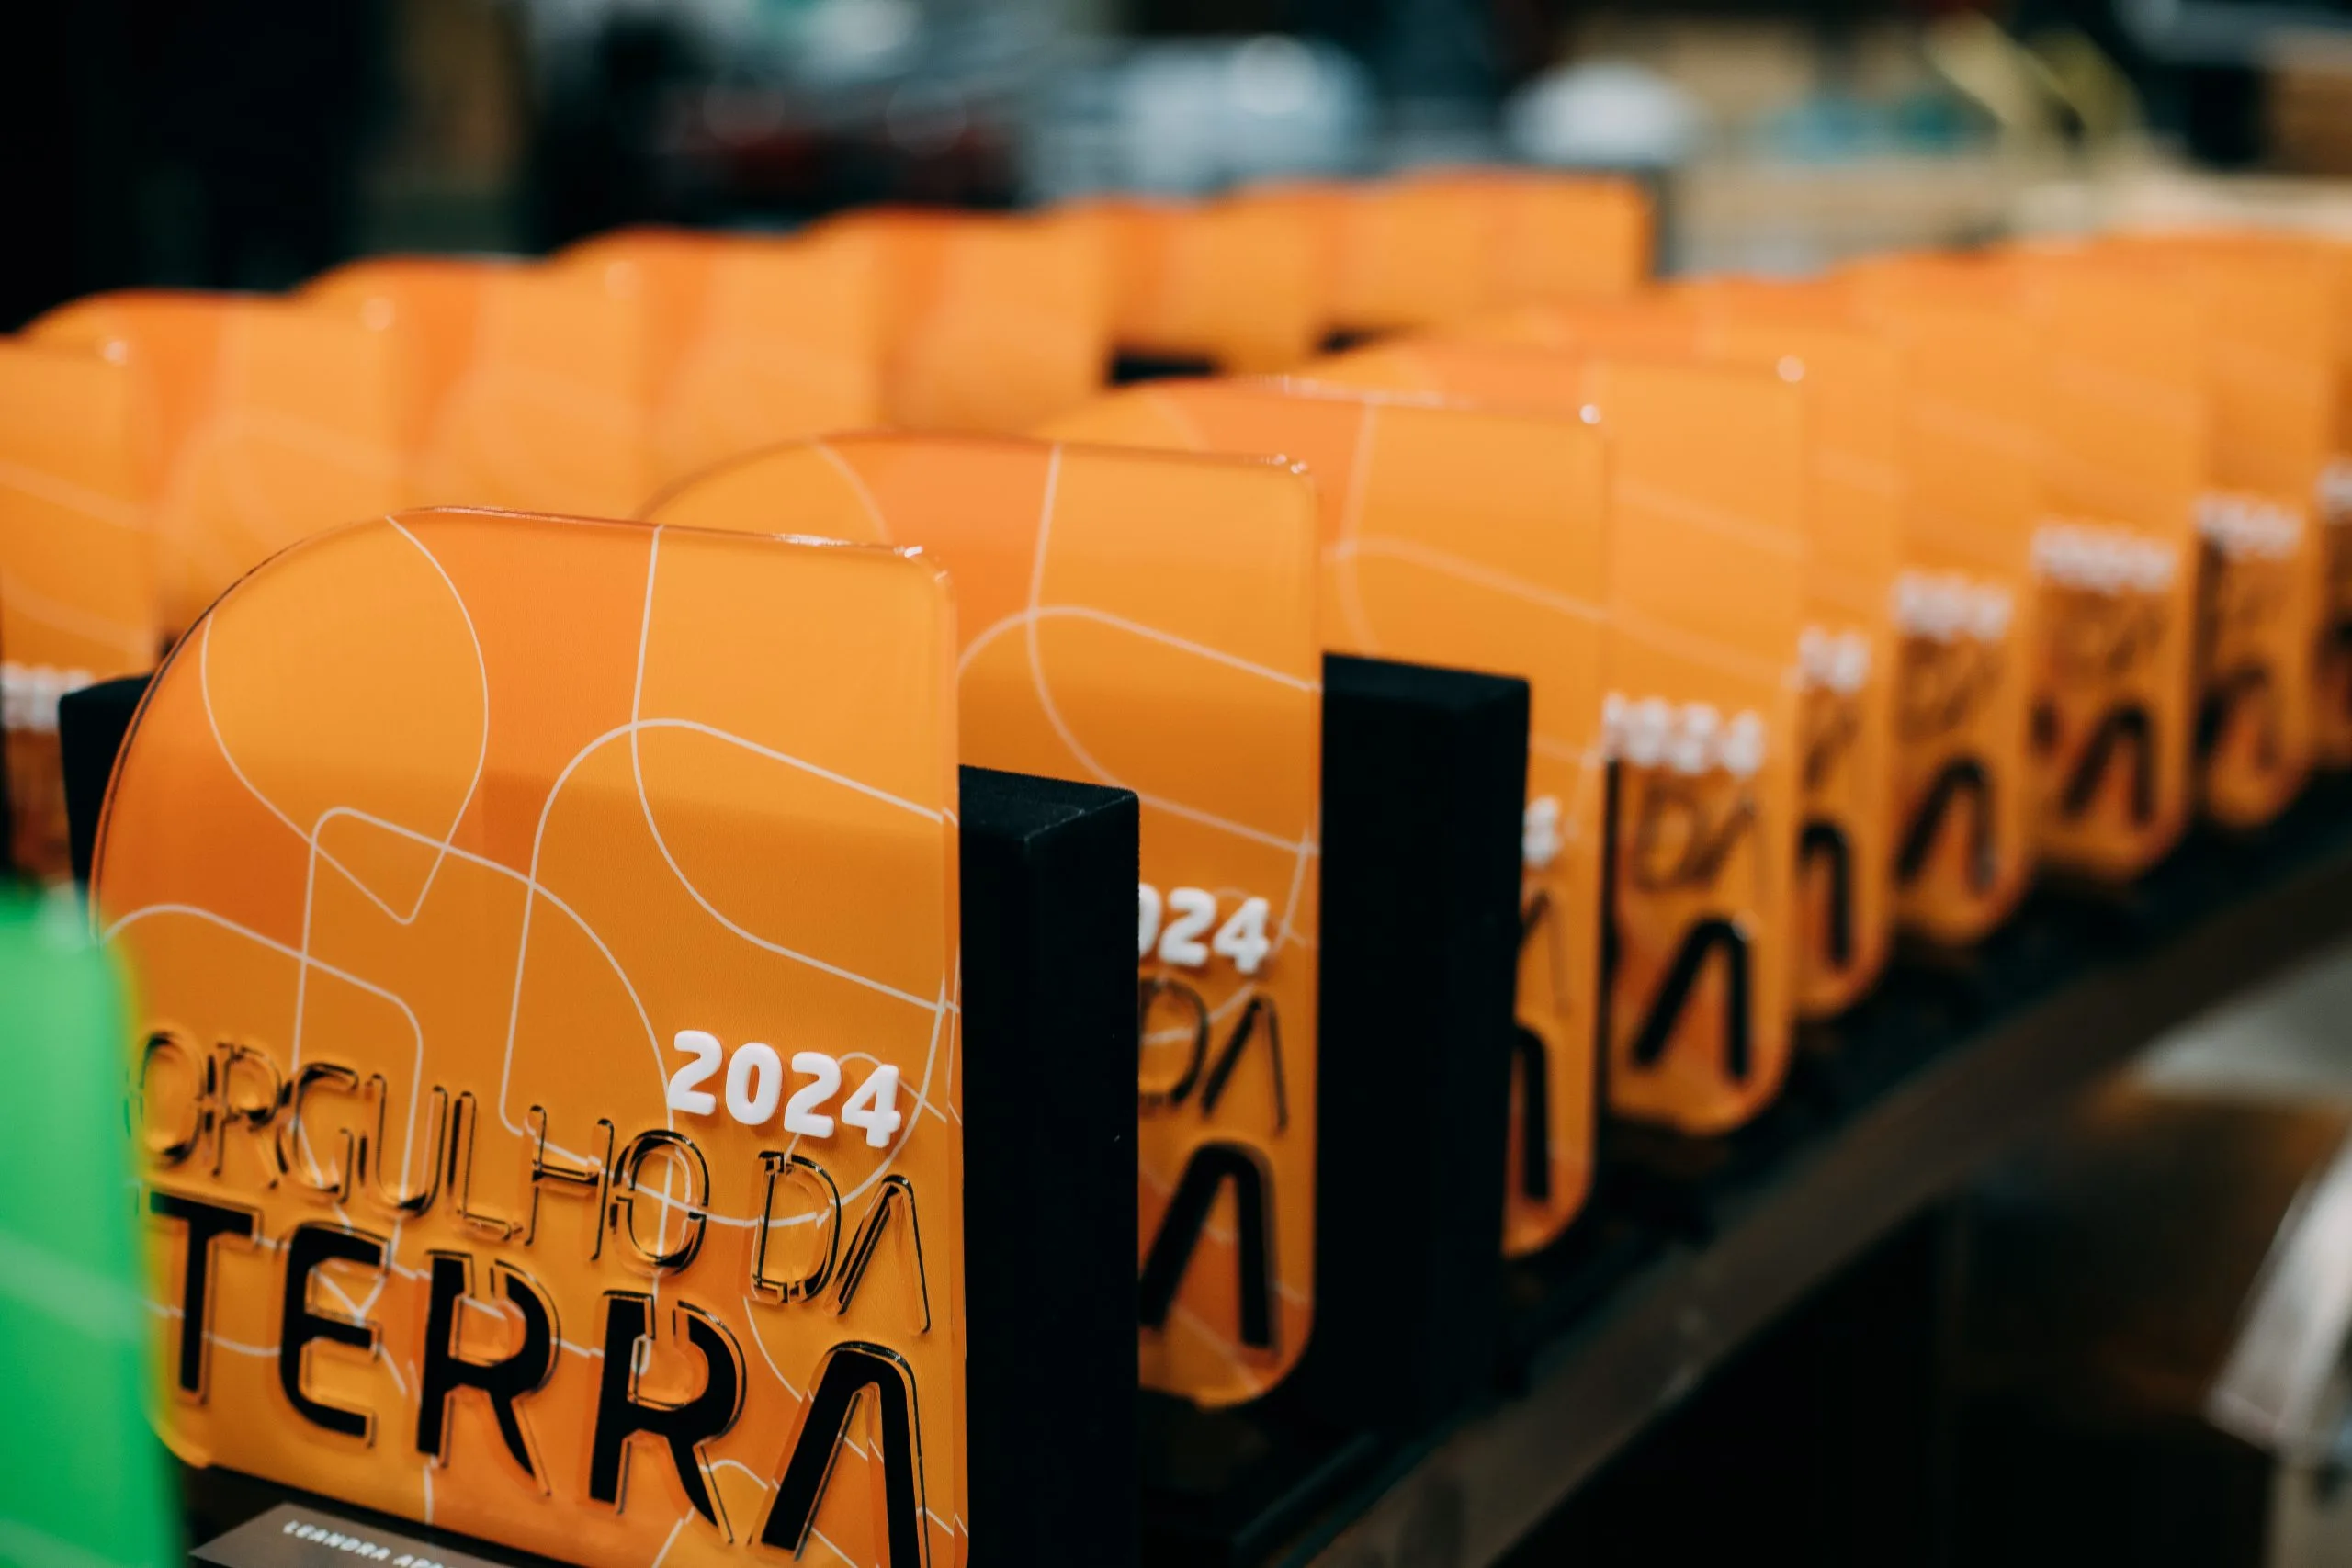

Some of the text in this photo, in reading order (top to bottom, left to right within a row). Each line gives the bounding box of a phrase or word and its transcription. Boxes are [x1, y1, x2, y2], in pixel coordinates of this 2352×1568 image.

[129, 1031, 710, 1275] ORGULHO
[752, 1150, 932, 1334] DA
[667, 1030, 901, 1148] 2024
[141, 1188, 932, 1568] TERRA
[283, 1520, 390, 1560] LEANDRA
